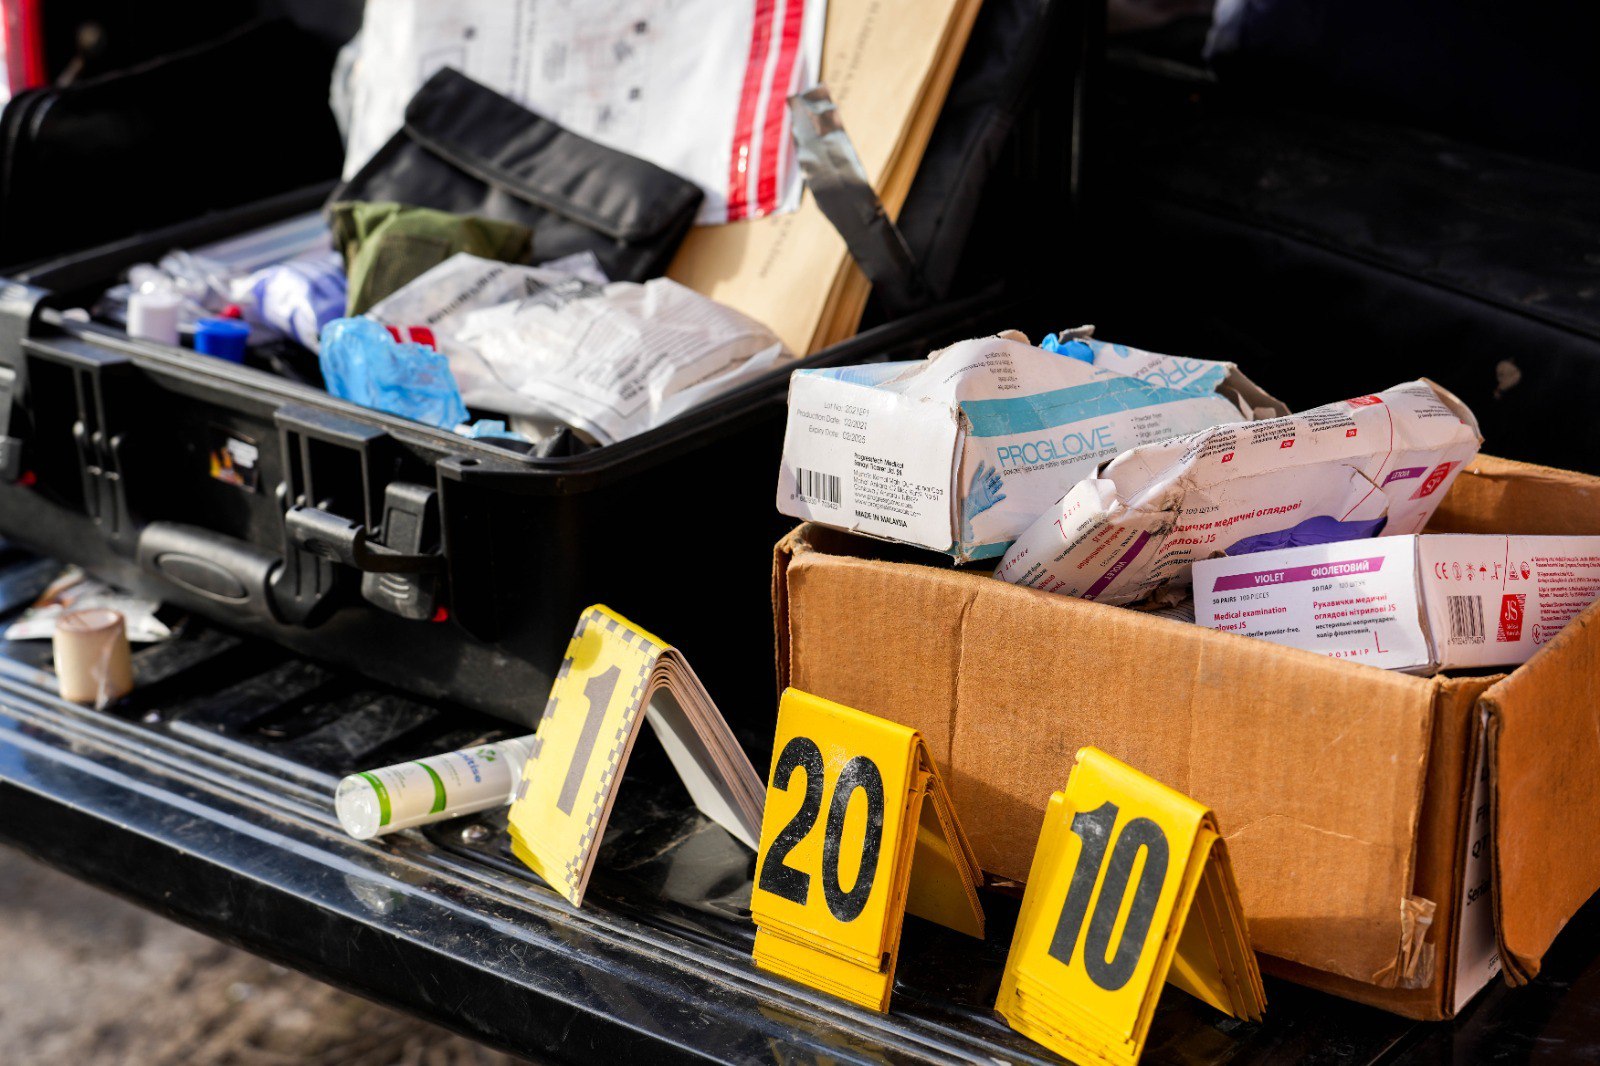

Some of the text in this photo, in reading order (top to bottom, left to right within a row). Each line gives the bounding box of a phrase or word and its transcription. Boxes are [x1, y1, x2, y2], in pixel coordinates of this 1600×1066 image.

[996, 425, 1116, 468] PROGLOVE
[1060, 451, 1097, 466] examination
[1098, 446, 1118, 458] gloves
[855, 510, 872, 520] MADE
[880, 516, 908, 527] MALAYSIA
[1214, 509, 1255, 528] медичні
[1256, 500, 1302, 518] оглядові
[1204, 533, 1216, 544] JS
[1077, 543, 1108, 570] examination
[1104, 560, 1127, 580] VIOLET
[1310, 560, 1370, 577] ФІОЛЕТОВИЙ
[1254, 572, 1285, 584] VIOLET
[1320, 584, 1333, 592] ПАР
[1313, 594, 1387, 609] Рукавички медичні
[1504, 600, 1518, 621] JS
[1214, 606, 1287, 621] Medical examination
[1314, 604, 1396, 620] оглядові нітрилові JS
[1215, 622, 1247, 632] gloves JS
[1315, 621, 1351, 629] нестерильні
[1374, 630, 1389, 653] L
[556, 664, 621, 817] 1
[758, 736, 884, 922] 20
[1048, 801, 1170, 991] 10
